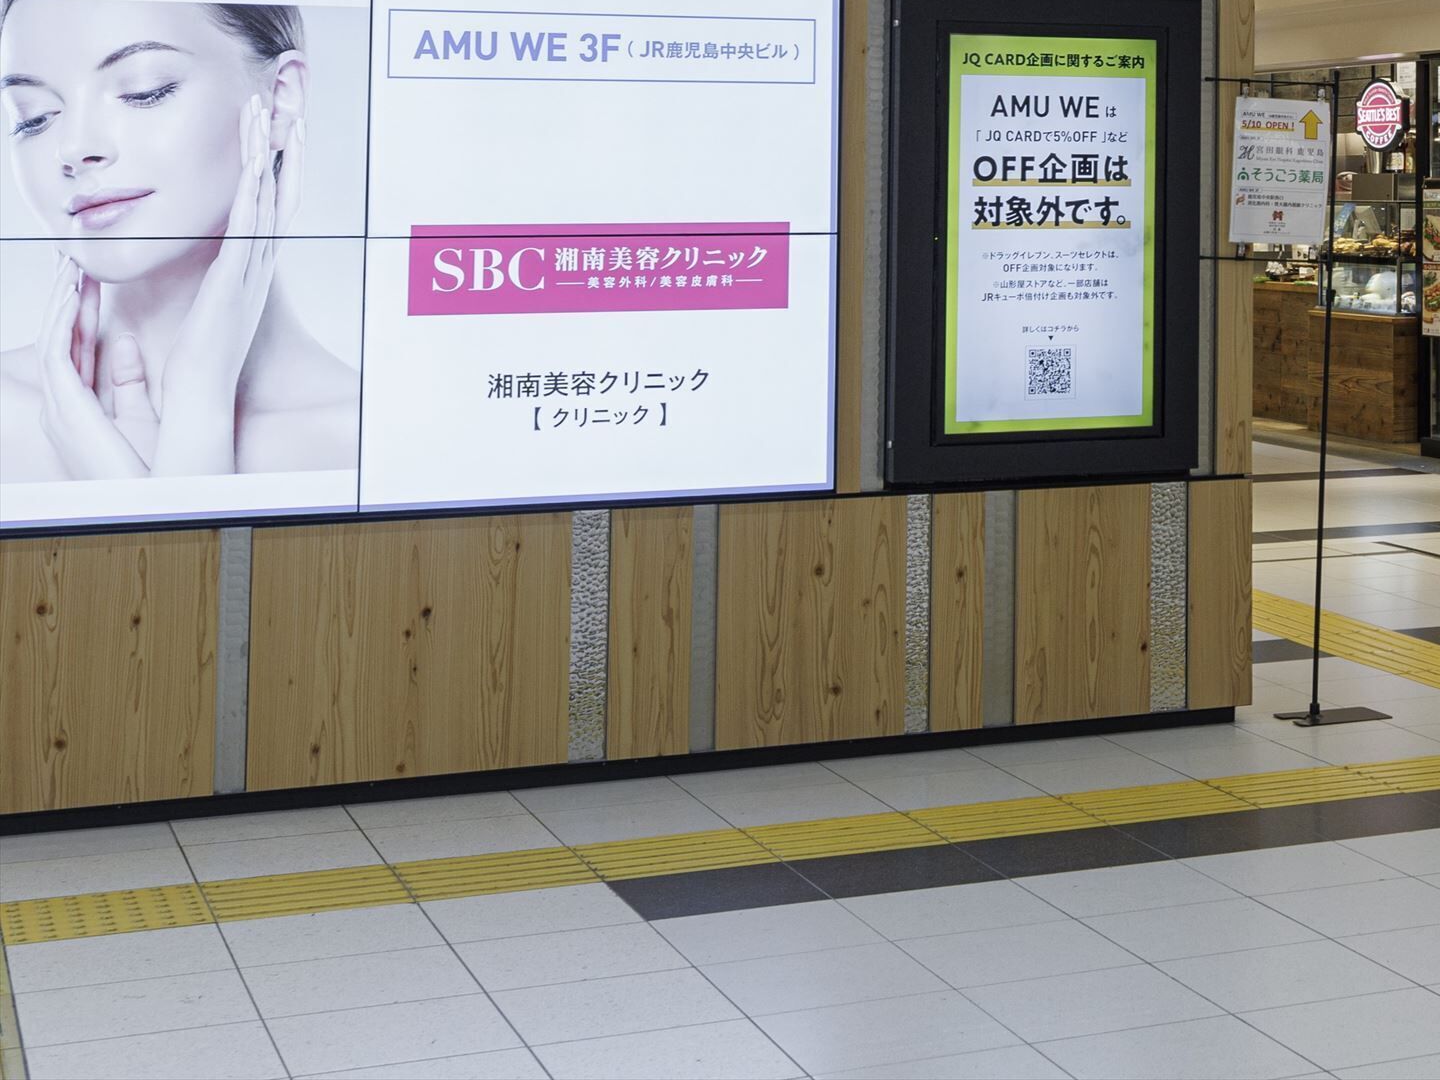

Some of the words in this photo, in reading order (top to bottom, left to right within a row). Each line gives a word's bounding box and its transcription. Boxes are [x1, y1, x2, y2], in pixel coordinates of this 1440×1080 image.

[414, 30, 498, 61] AMU
[510, 32, 568, 62] WE
[579, 33, 621, 62] 3F
[962, 53, 981, 67] JQ
[984, 53, 1145, 69] CARD企画に関するご案内
[990, 95, 1050, 118] AMU
[1059, 96, 1100, 118] WE
[1105, 106, 1117, 118] は
[1385, 106, 1401, 123] BEST
[1242, 119, 1261, 129] 5/10
[1265, 121, 1289, 130] OPEN
[1365, 130, 1393, 145] COFFEE
[973, 153, 1129, 184] OFF企画は
[1251, 167, 1324, 184] そうごう薬局
[974, 195, 1126, 227] 対象外です。
[432, 247, 545, 292] SBC
[554, 245, 768, 272] 湘南美容クリニック
[487, 368, 711, 399] 湘南美容クリニック
